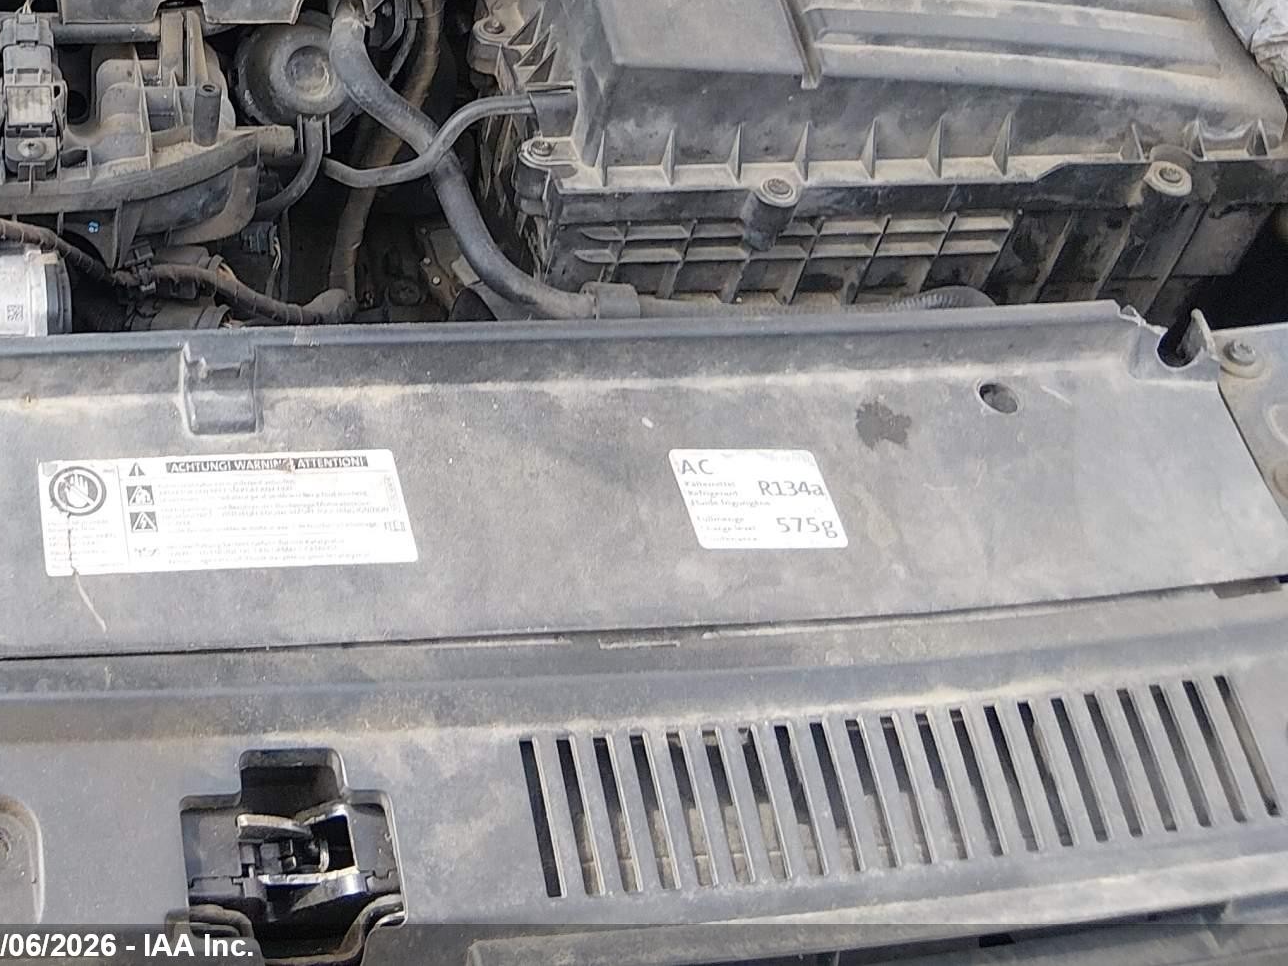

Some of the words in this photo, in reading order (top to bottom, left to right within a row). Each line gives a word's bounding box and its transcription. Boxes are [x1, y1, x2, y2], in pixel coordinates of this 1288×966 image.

[171, 460, 232, 473] ACHTUNG!
[297, 456, 364, 469] ATTENTION!
[680, 458, 715, 474] AC
[757, 480, 825, 497] R134a
[775, 517, 839, 539] 575g
